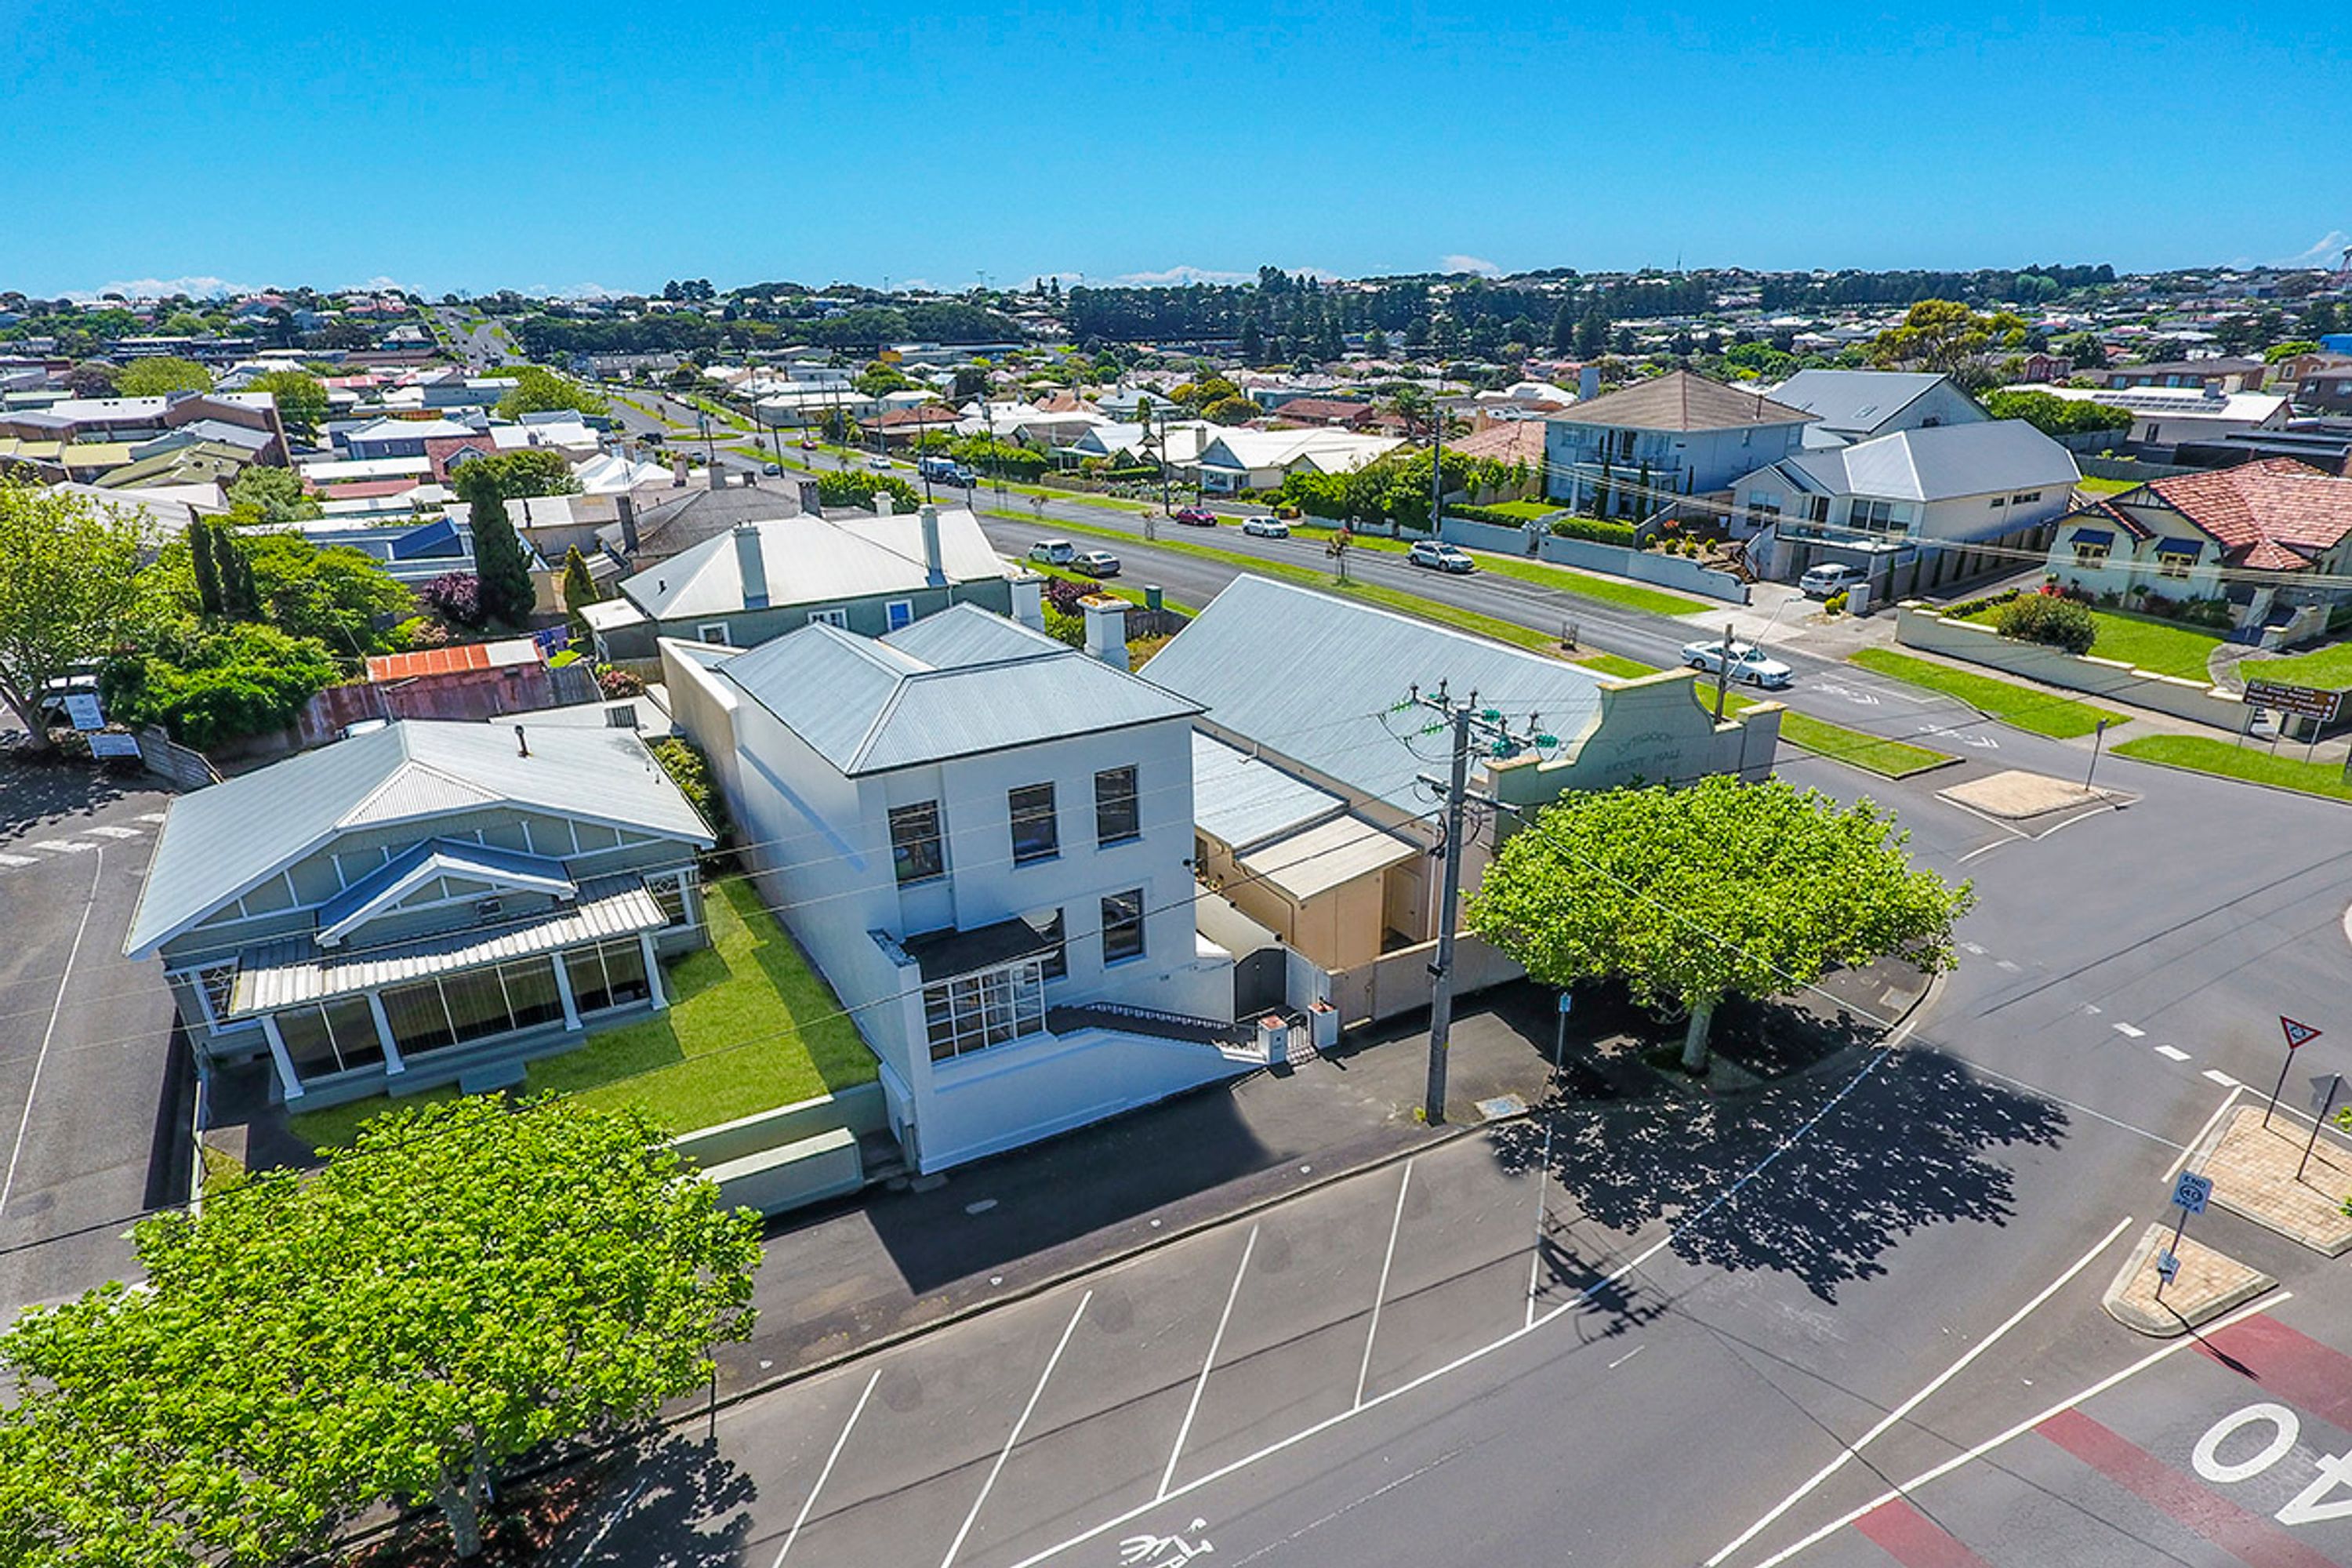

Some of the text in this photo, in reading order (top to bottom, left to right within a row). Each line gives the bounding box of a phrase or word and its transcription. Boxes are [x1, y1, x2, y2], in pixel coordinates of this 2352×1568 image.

[2183, 1175, 2206, 1189] END
[2183, 1189, 2200, 1200] 40
[2174, 1199, 2200, 1214] AREA
